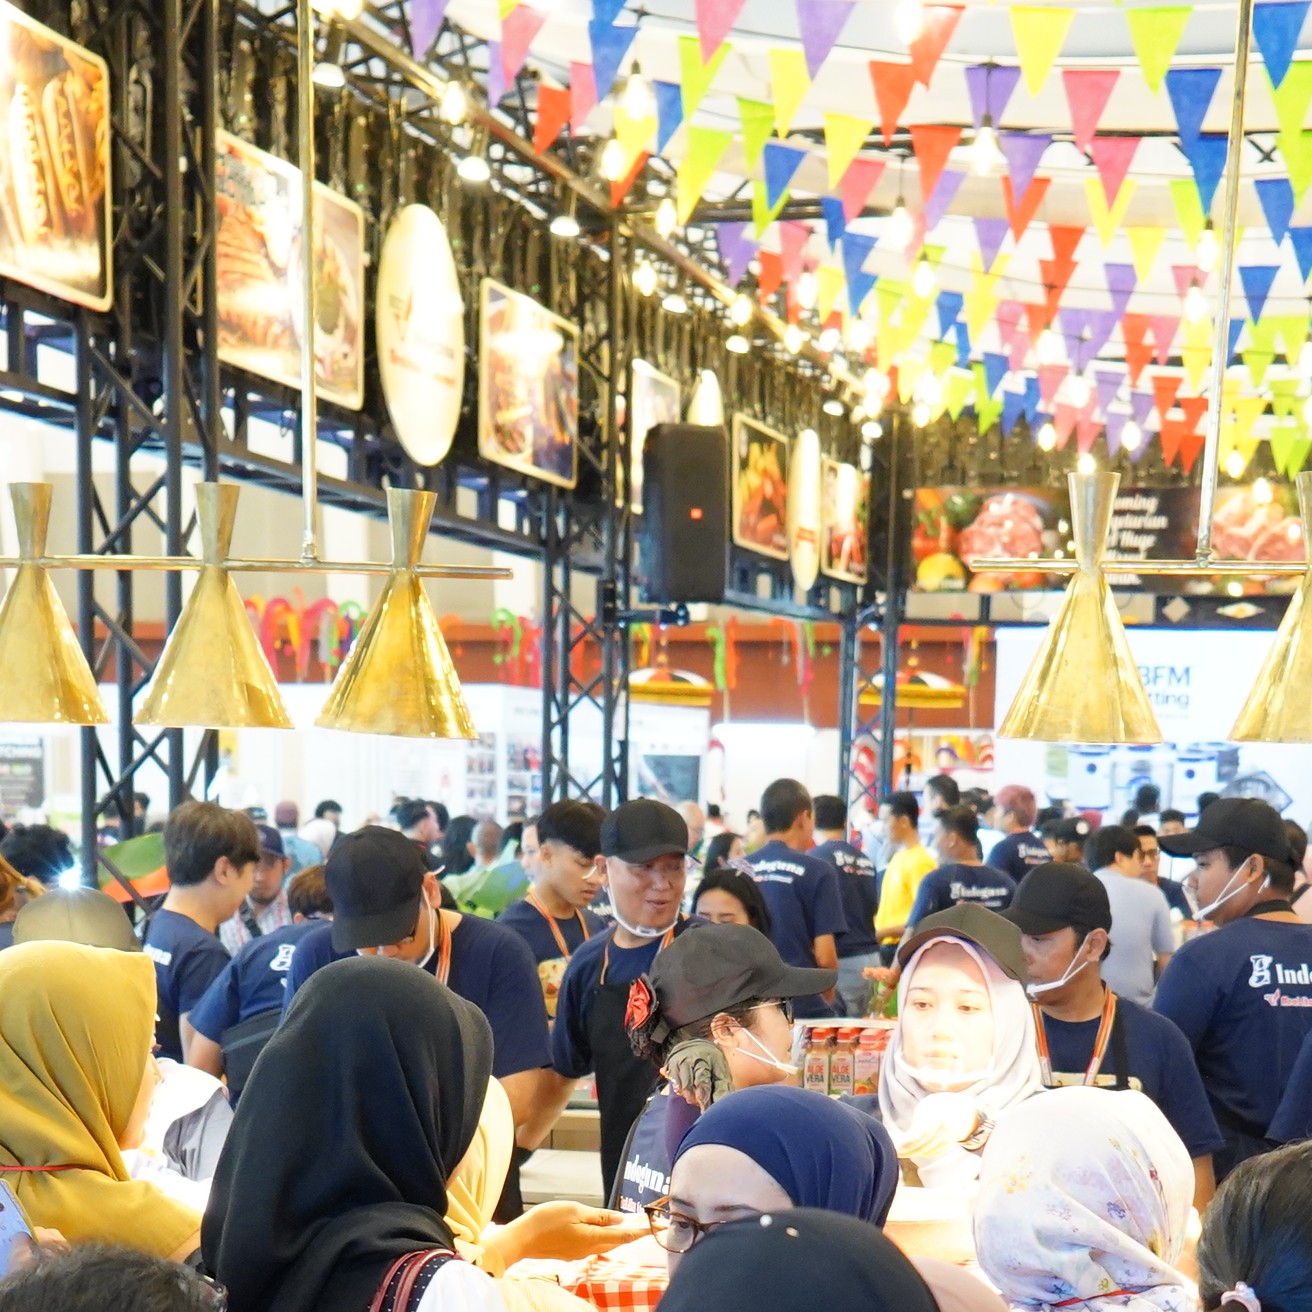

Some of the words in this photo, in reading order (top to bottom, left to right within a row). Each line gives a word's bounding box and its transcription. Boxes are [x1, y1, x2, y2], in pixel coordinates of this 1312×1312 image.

[808, 1065, 824, 1074] ALOE
[832, 1065, 849, 1074] ALOE
[807, 1074, 824, 1083] VERA
[832, 1074, 850, 1083] VERA
